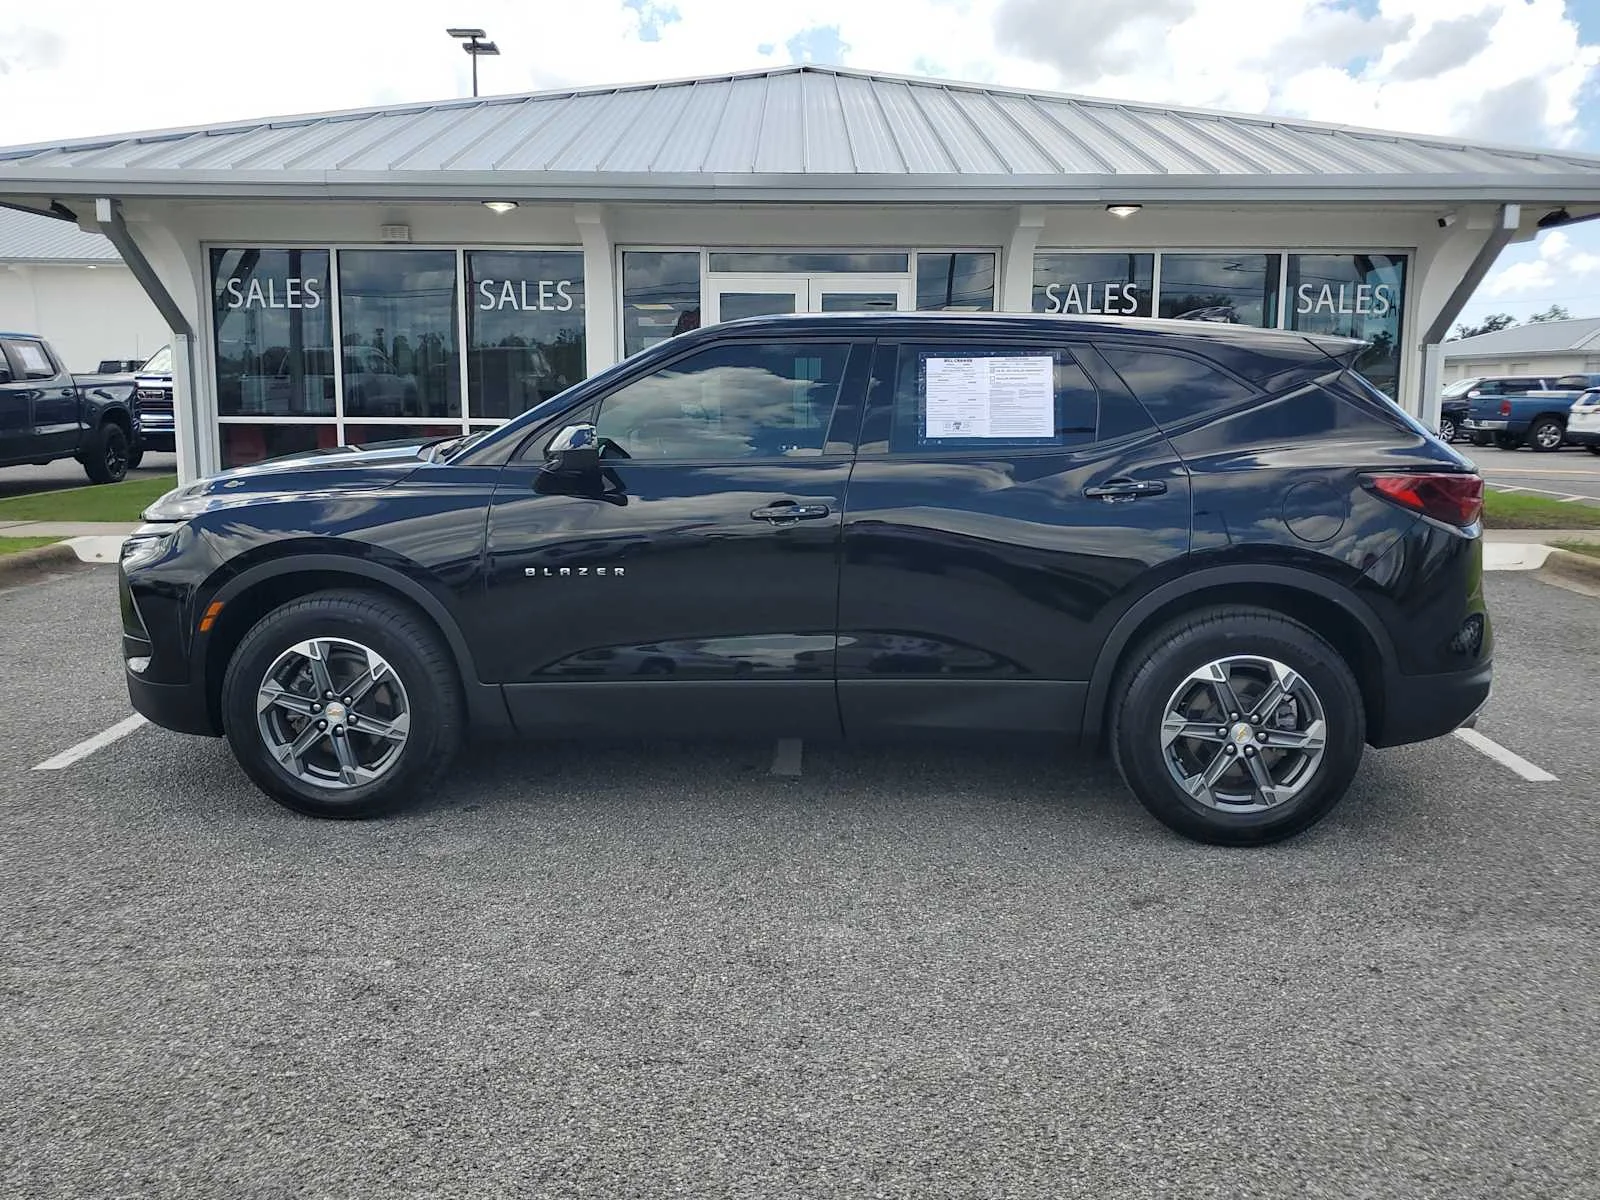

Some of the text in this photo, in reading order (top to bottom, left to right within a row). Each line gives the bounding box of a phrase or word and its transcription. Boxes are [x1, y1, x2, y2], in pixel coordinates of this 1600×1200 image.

[227, 278, 321, 309] SALES
[479, 279, 573, 311] SALES
[1045, 283, 1138, 314] SALES
[1297, 283, 1390, 315] SALES
[524, 567, 626, 577] BLAZER
